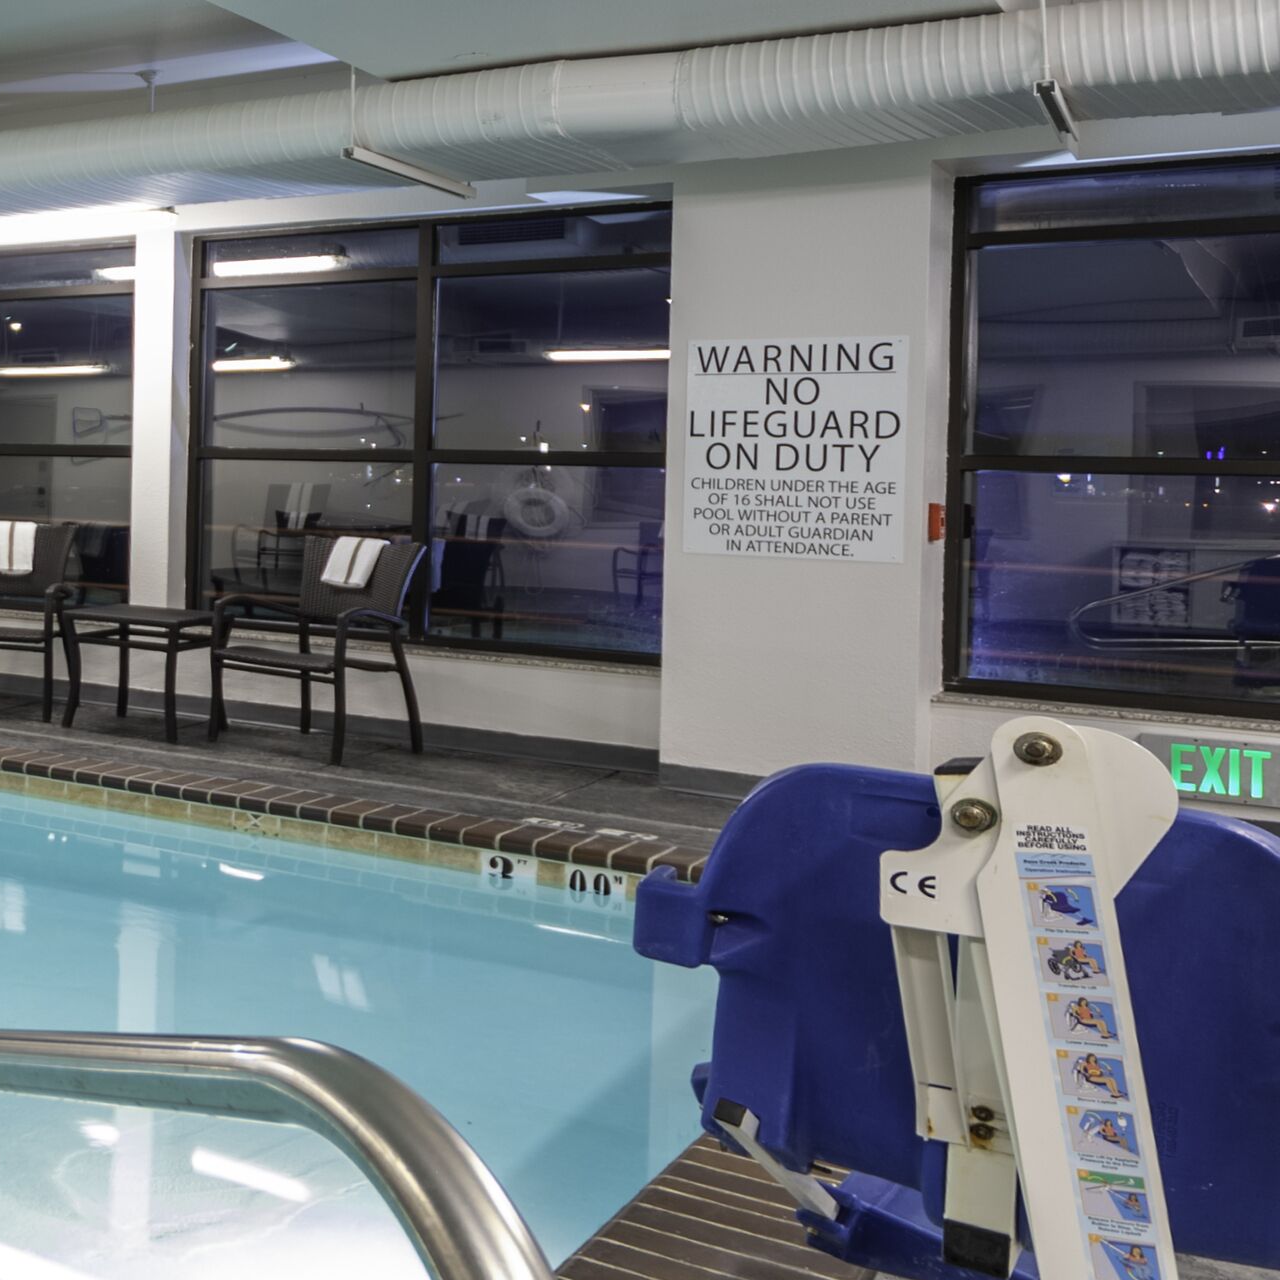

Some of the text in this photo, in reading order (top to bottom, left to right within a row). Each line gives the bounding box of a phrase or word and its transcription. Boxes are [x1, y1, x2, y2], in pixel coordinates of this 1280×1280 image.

[697, 342, 895, 373] WARNING
[765, 377, 820, 405] NO
[690, 410, 901, 439] LIFEGUARD
[706, 442, 881, 473] ON DUTY
[691, 477, 896, 495] CHILDREN UNDER THE AGE
[708, 493, 876, 511] OF 16 SHALL NOT USE
[693, 508, 892, 527] POOL WITHOUT A PARENT
[709, 523, 874, 542] OR ADULT GUARDIAN
[726, 539, 854, 557] IN ATTENDANCE.
[1171, 743, 1271, 799] EXIT
[1016, 830, 1086, 840] INSTRUCTIONS
[1018, 841, 1087, 851] BEFORE USING
